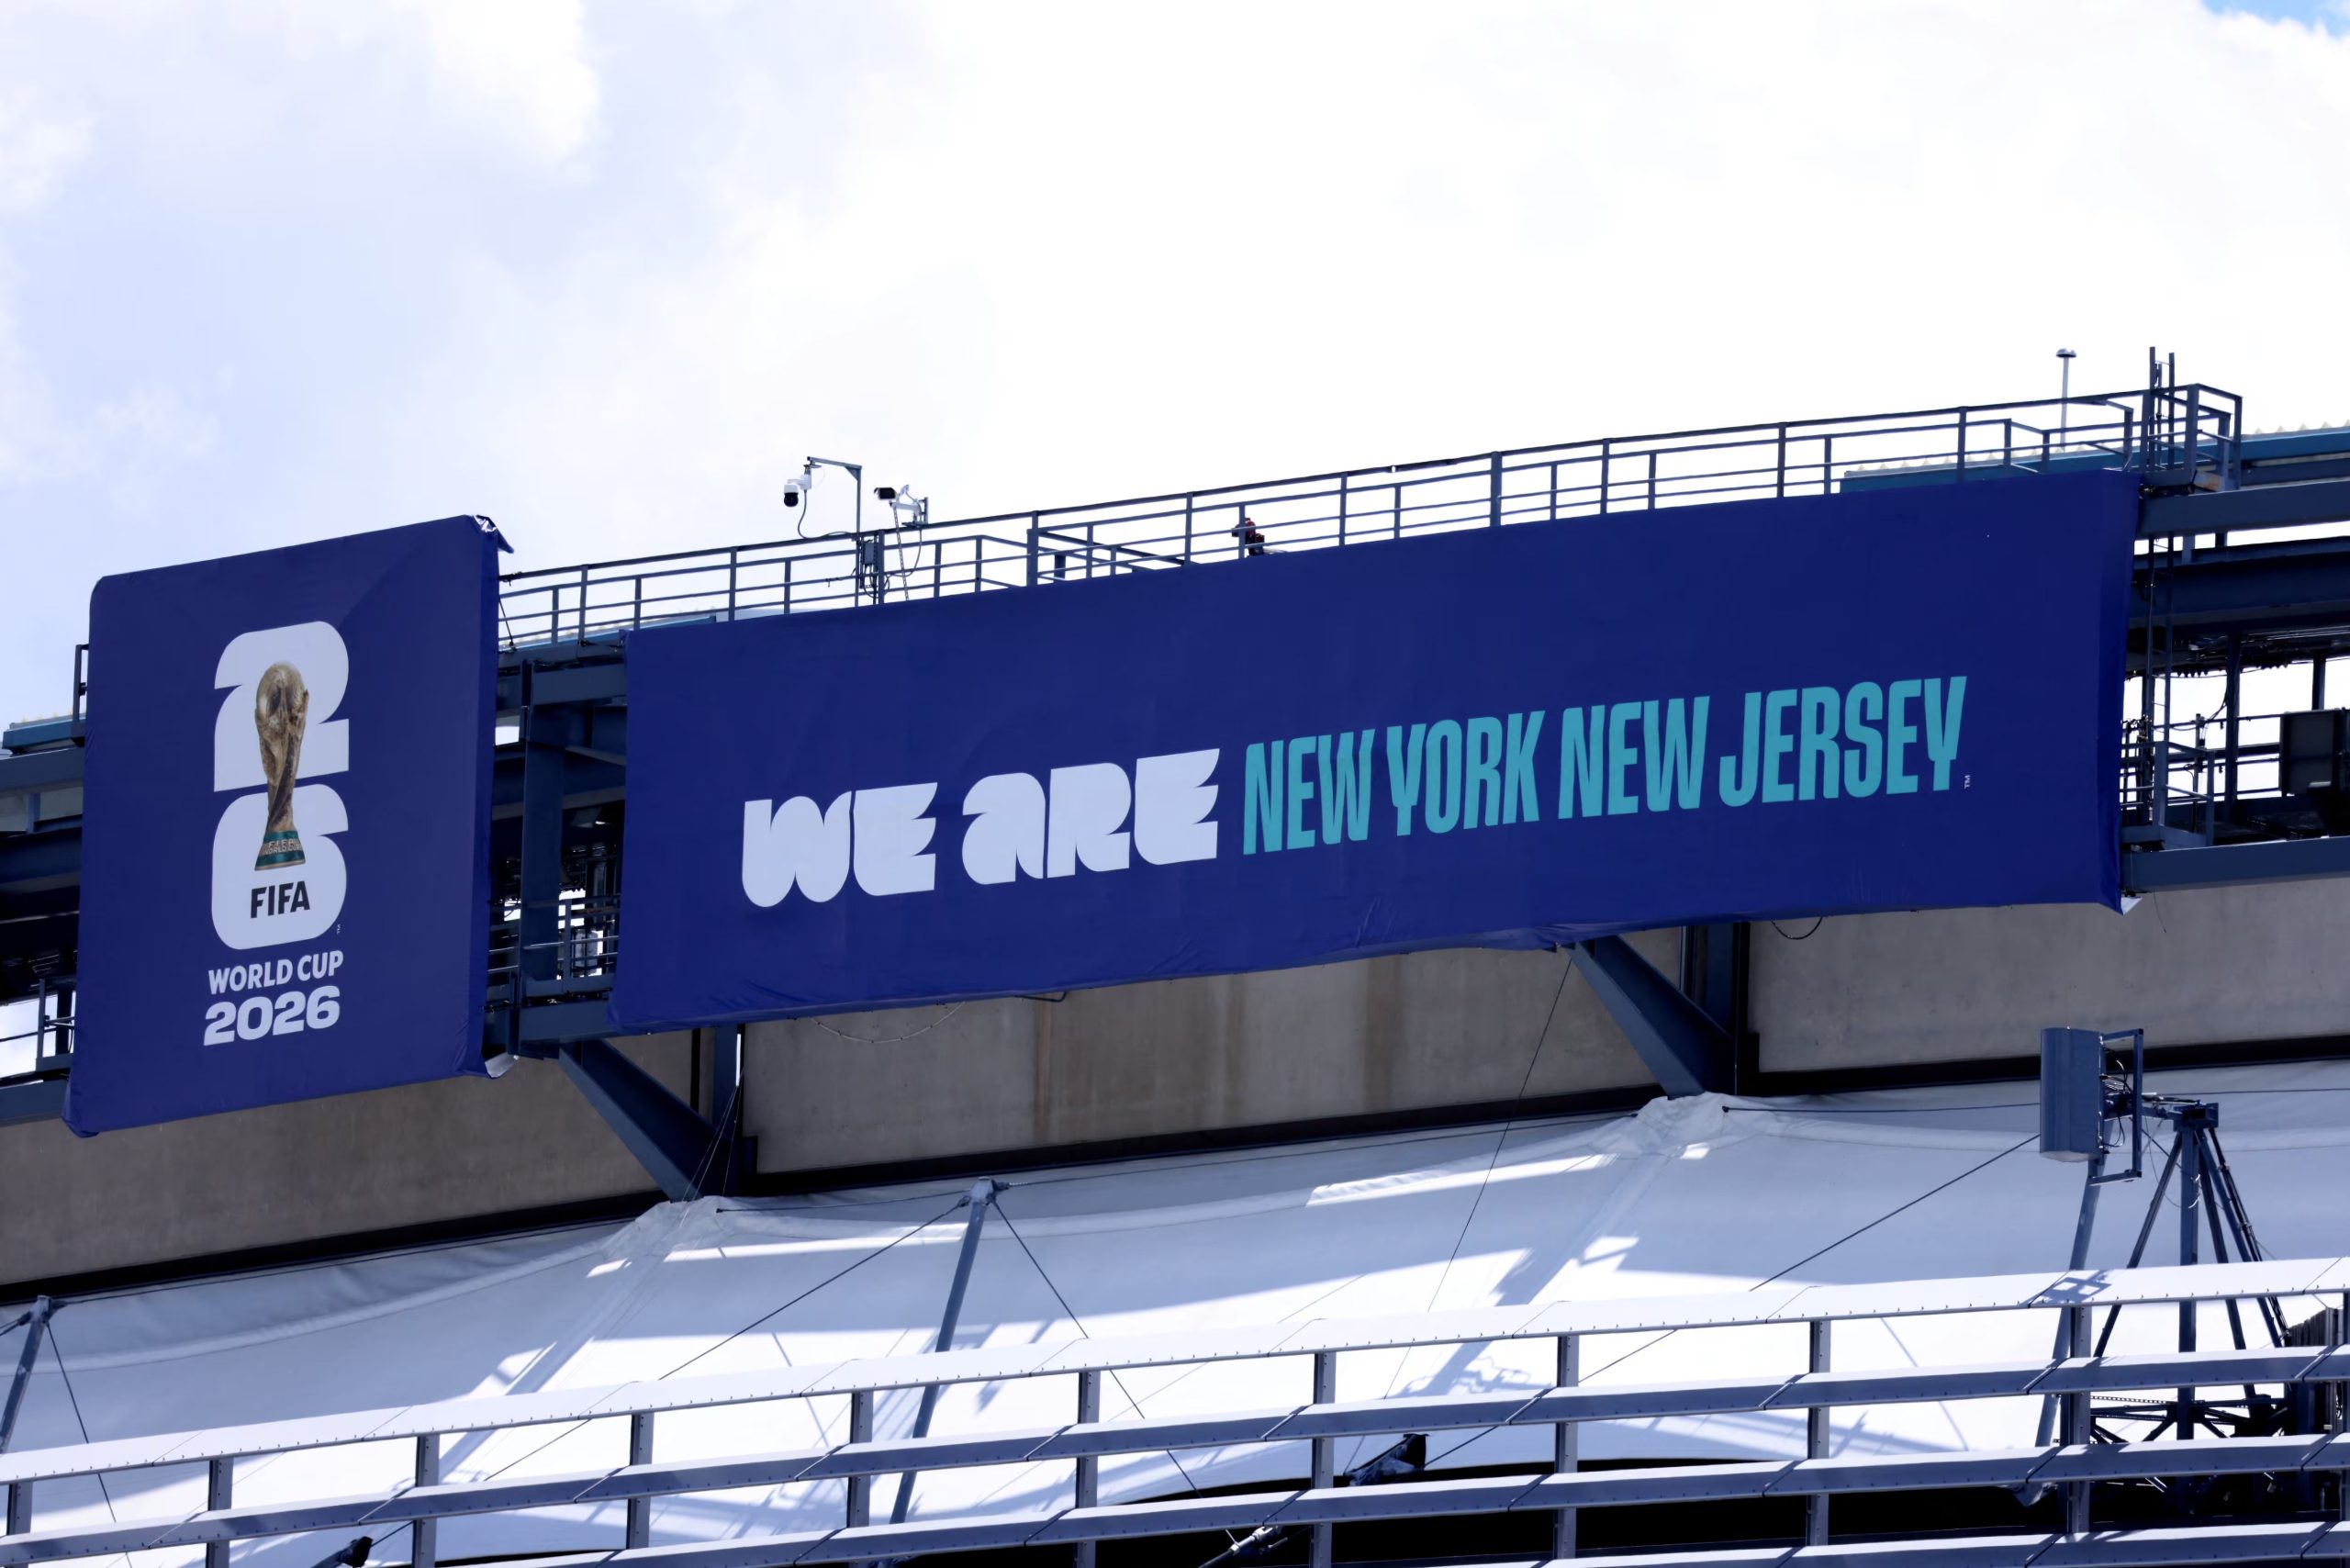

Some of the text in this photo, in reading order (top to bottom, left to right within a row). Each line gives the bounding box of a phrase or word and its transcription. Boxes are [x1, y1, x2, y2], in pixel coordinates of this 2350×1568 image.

[741, 676, 1967, 908] WE ARE NEW YORK NEW JERSEY
[268, 838, 295, 848] FIFA
[251, 880, 310, 919] FIFA
[207, 949, 344, 995] WORLD CUP
[203, 985, 341, 1047] 2026
